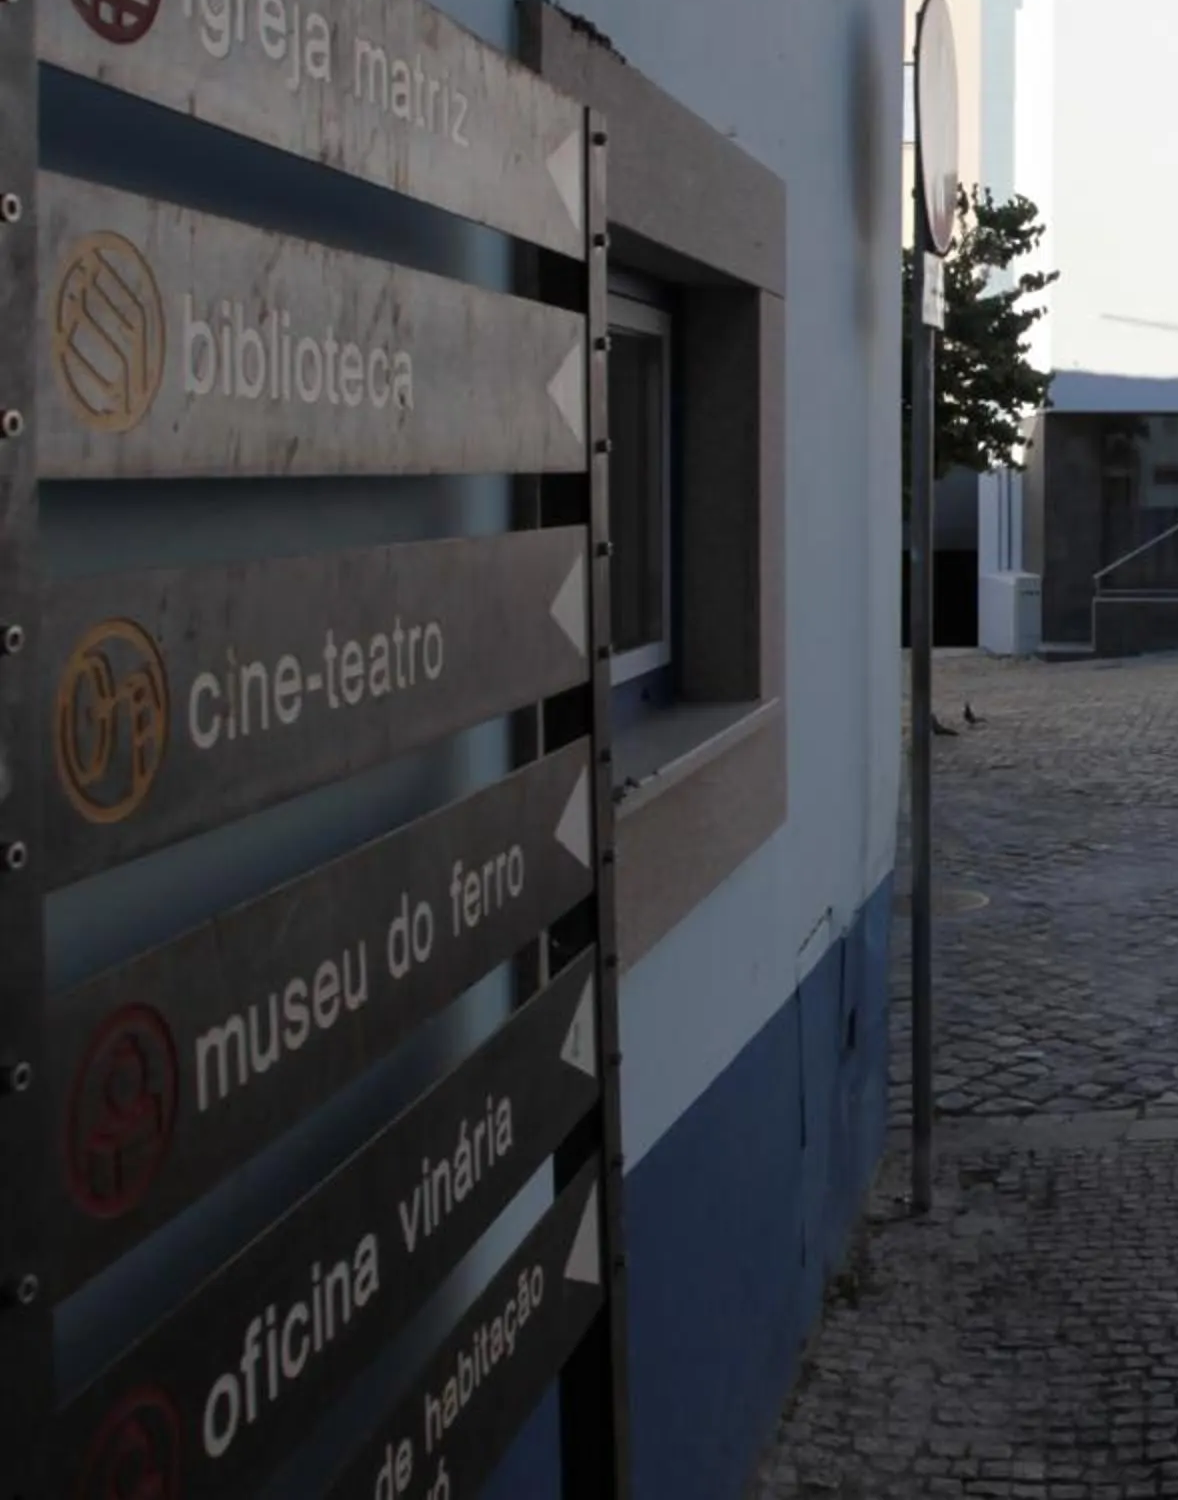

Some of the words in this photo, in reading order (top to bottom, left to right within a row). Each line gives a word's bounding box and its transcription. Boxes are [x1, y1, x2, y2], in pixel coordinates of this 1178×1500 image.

[353, 37, 469, 148] matriz
[181, 295, 414, 411] biblioteca
[188, 615, 445, 749] cine-teatro
[195, 940, 369, 1112] museu
[387, 892, 434, 977] do
[450, 844, 524, 937] ferro
[203, 1233, 379, 1457] oficina
[399, 1095, 513, 1252] vinária
[375, 1436, 413, 1500] de
[424, 1265, 543, 1453] habitação
